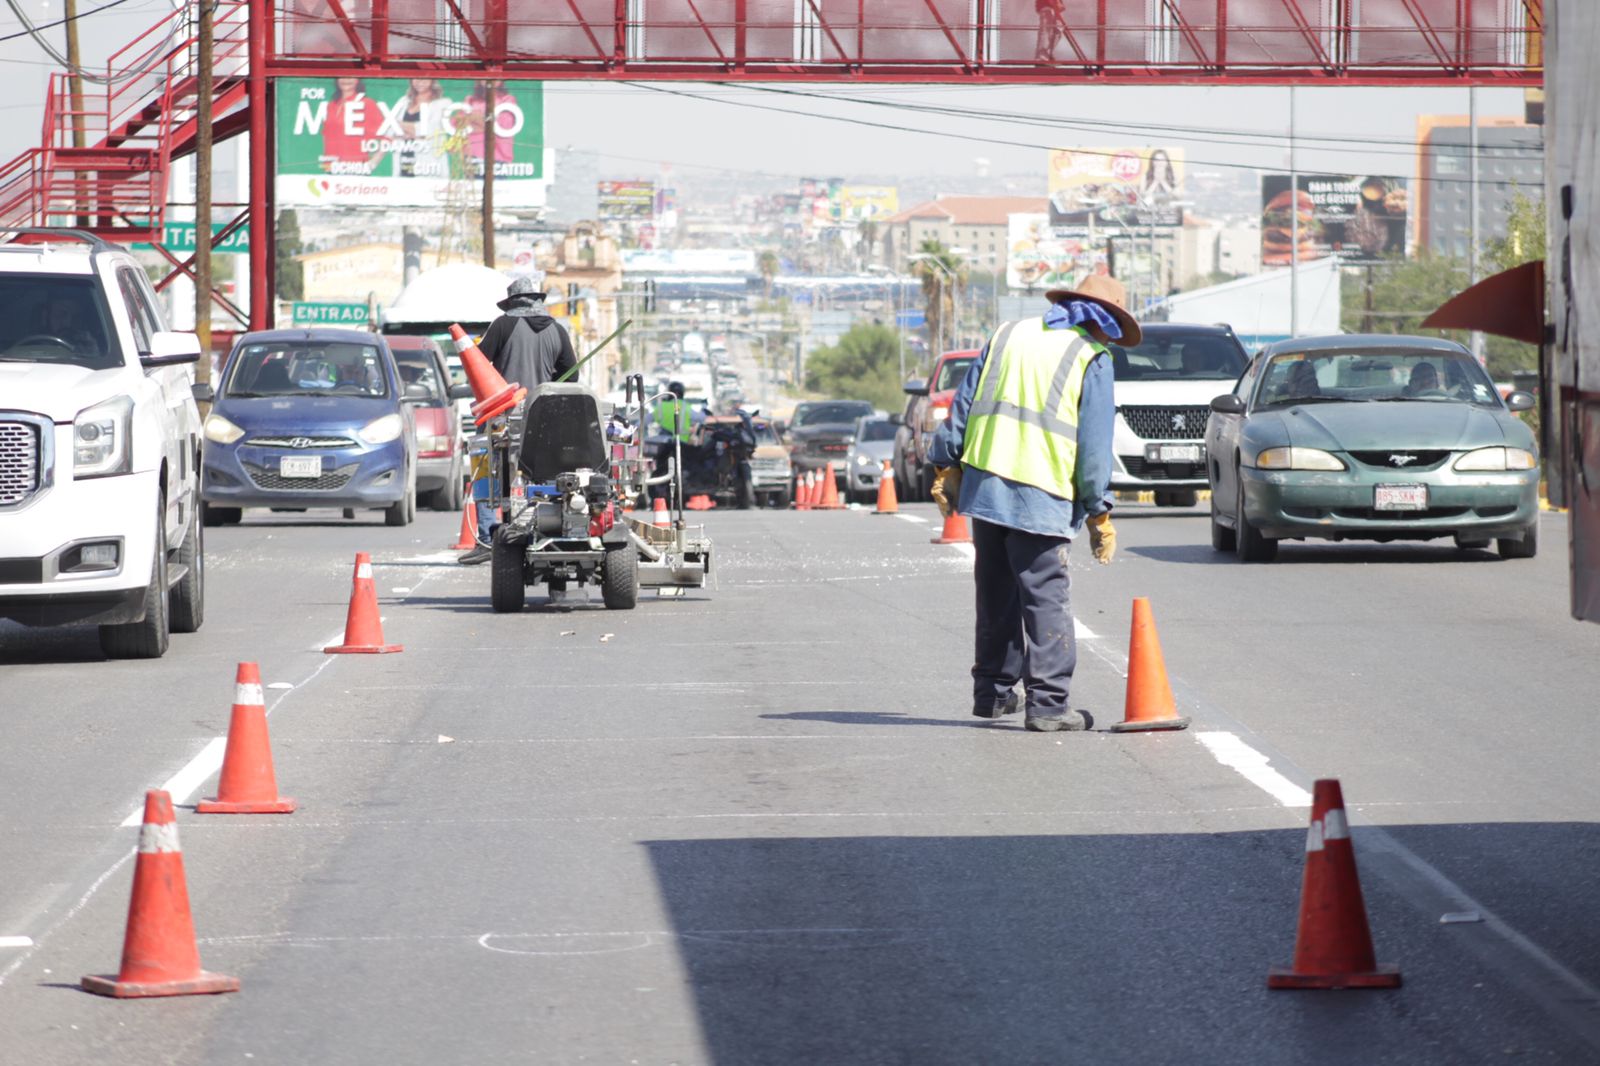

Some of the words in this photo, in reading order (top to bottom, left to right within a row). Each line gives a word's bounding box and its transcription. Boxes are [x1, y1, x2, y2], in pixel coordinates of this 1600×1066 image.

[301, 87, 326, 99] POR
[293, 92, 524, 138] MÉXICO
[361, 139, 379, 153] LO
[335, 182, 388, 196] Soriana
[1308, 181, 1332, 192] PARA
